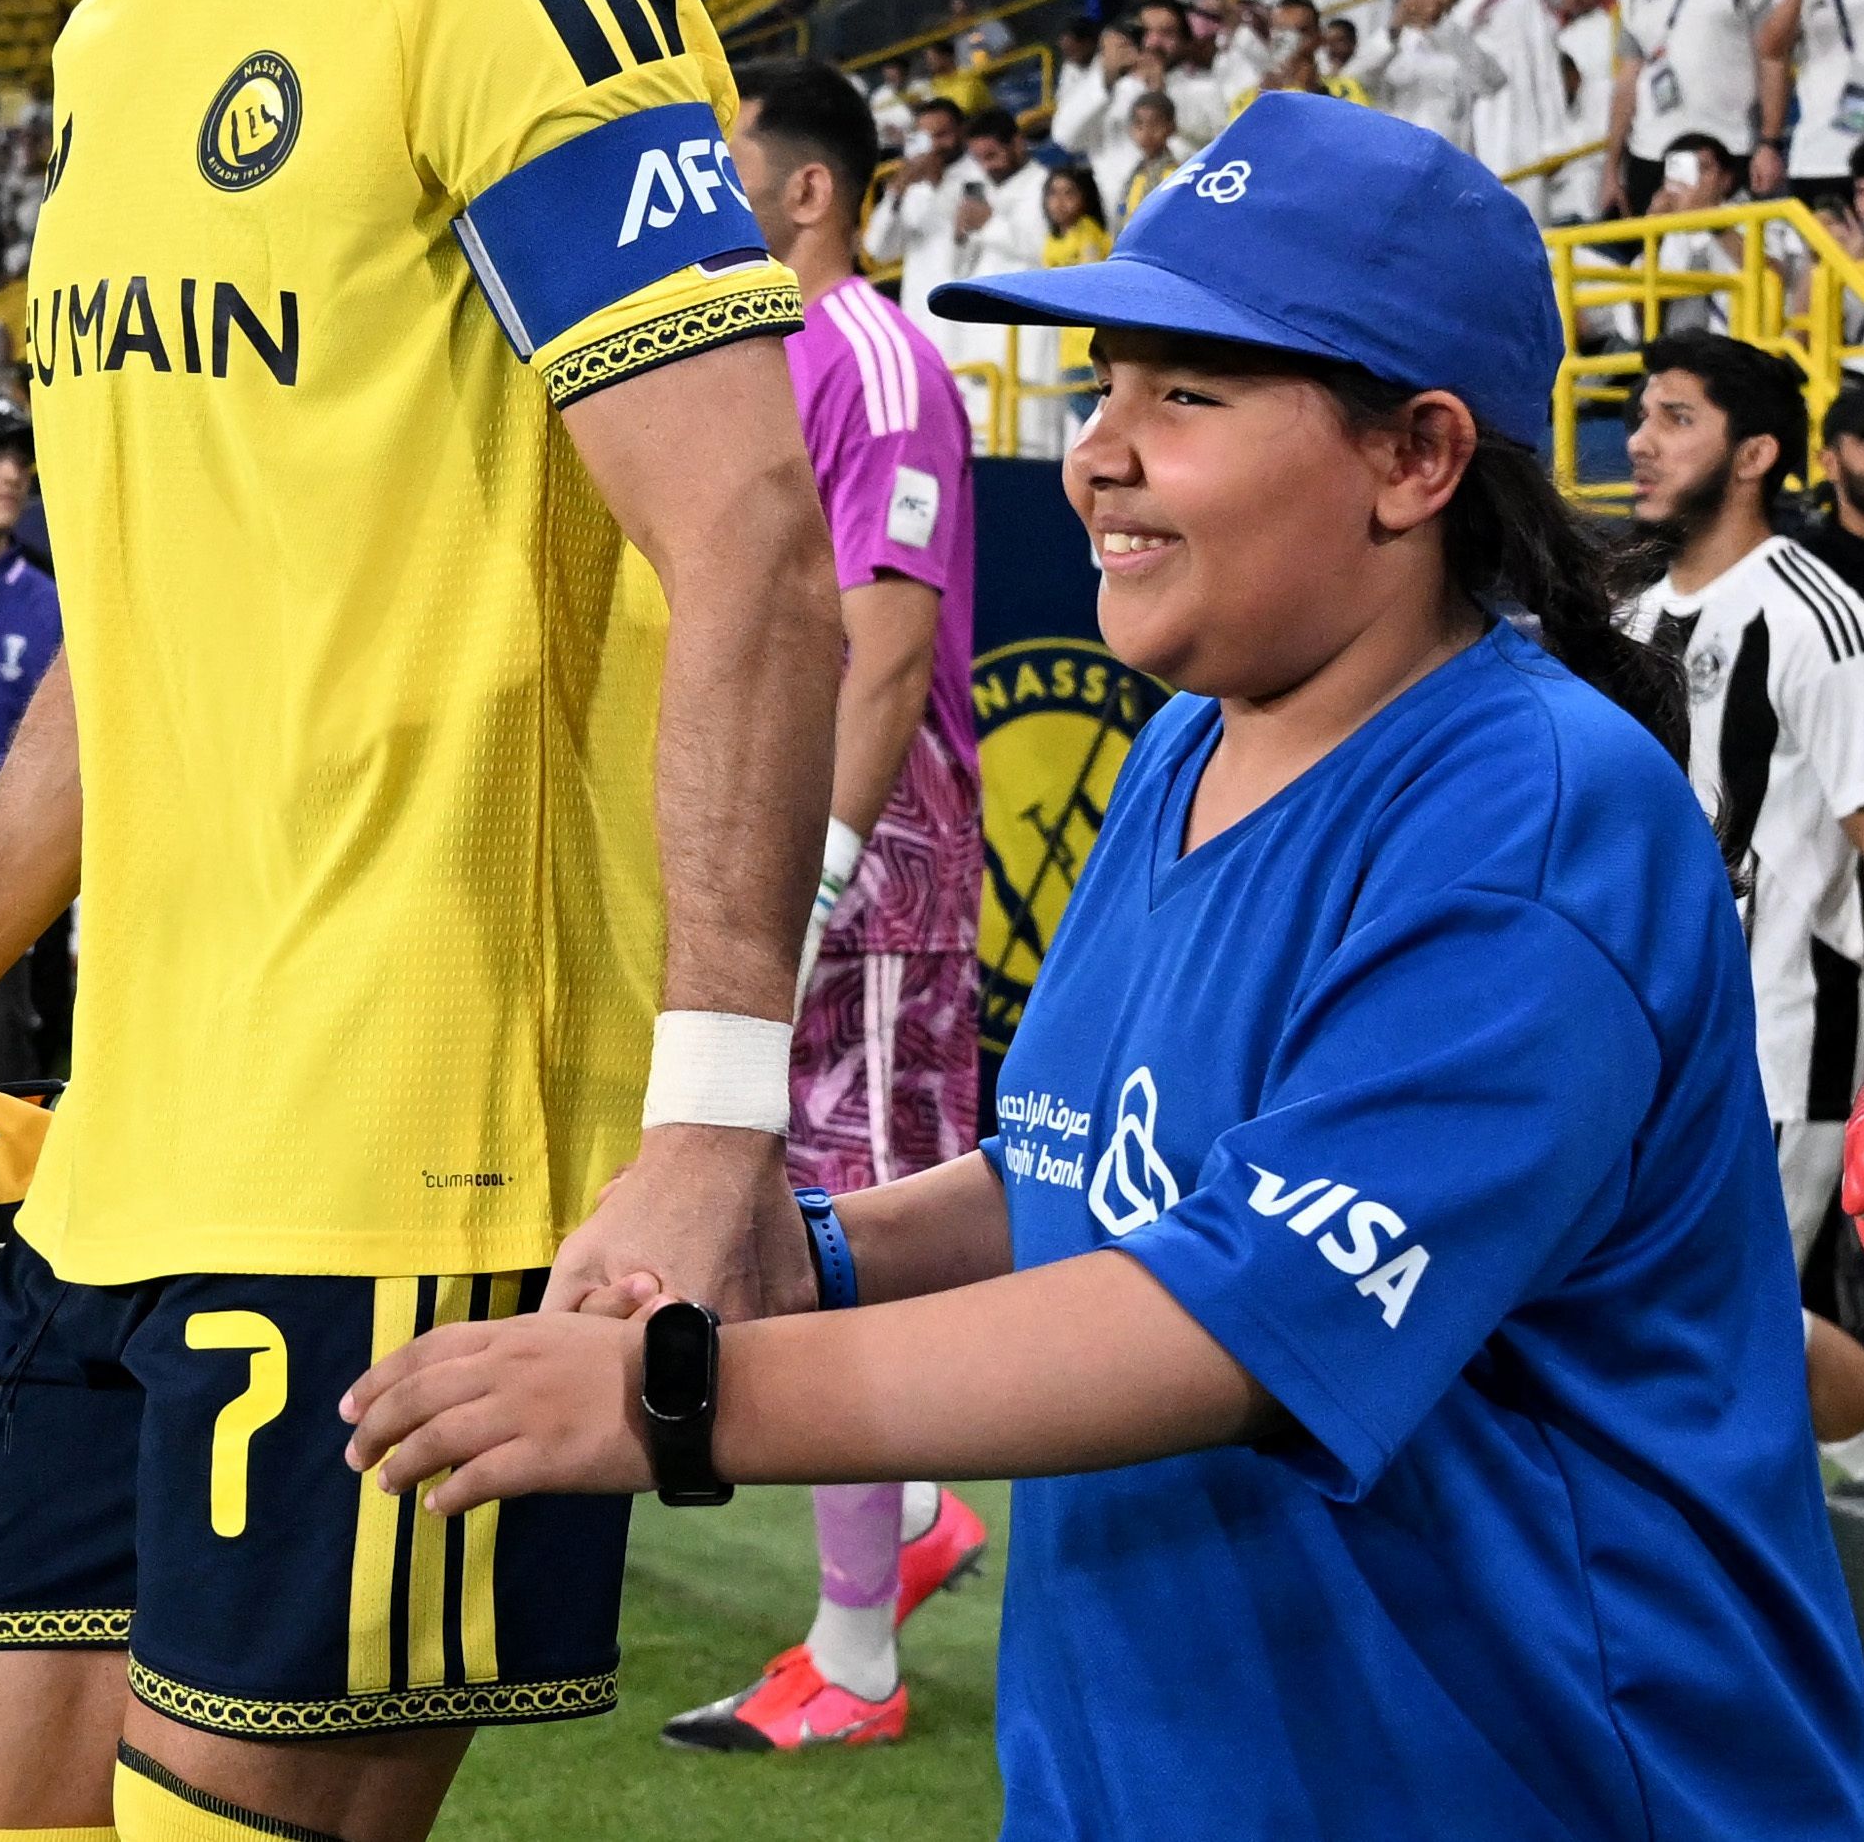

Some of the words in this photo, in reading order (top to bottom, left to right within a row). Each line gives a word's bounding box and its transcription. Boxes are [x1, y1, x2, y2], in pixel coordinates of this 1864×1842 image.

[244, 60, 283, 81] NASSR
[207, 156, 239, 182] RIYADH
[26, 275, 299, 388] UMAIN
[1035, 1144, 1085, 1191] bank
[1246, 1162, 1431, 1330] VISA
[184, 1310, 288, 1539] 7
